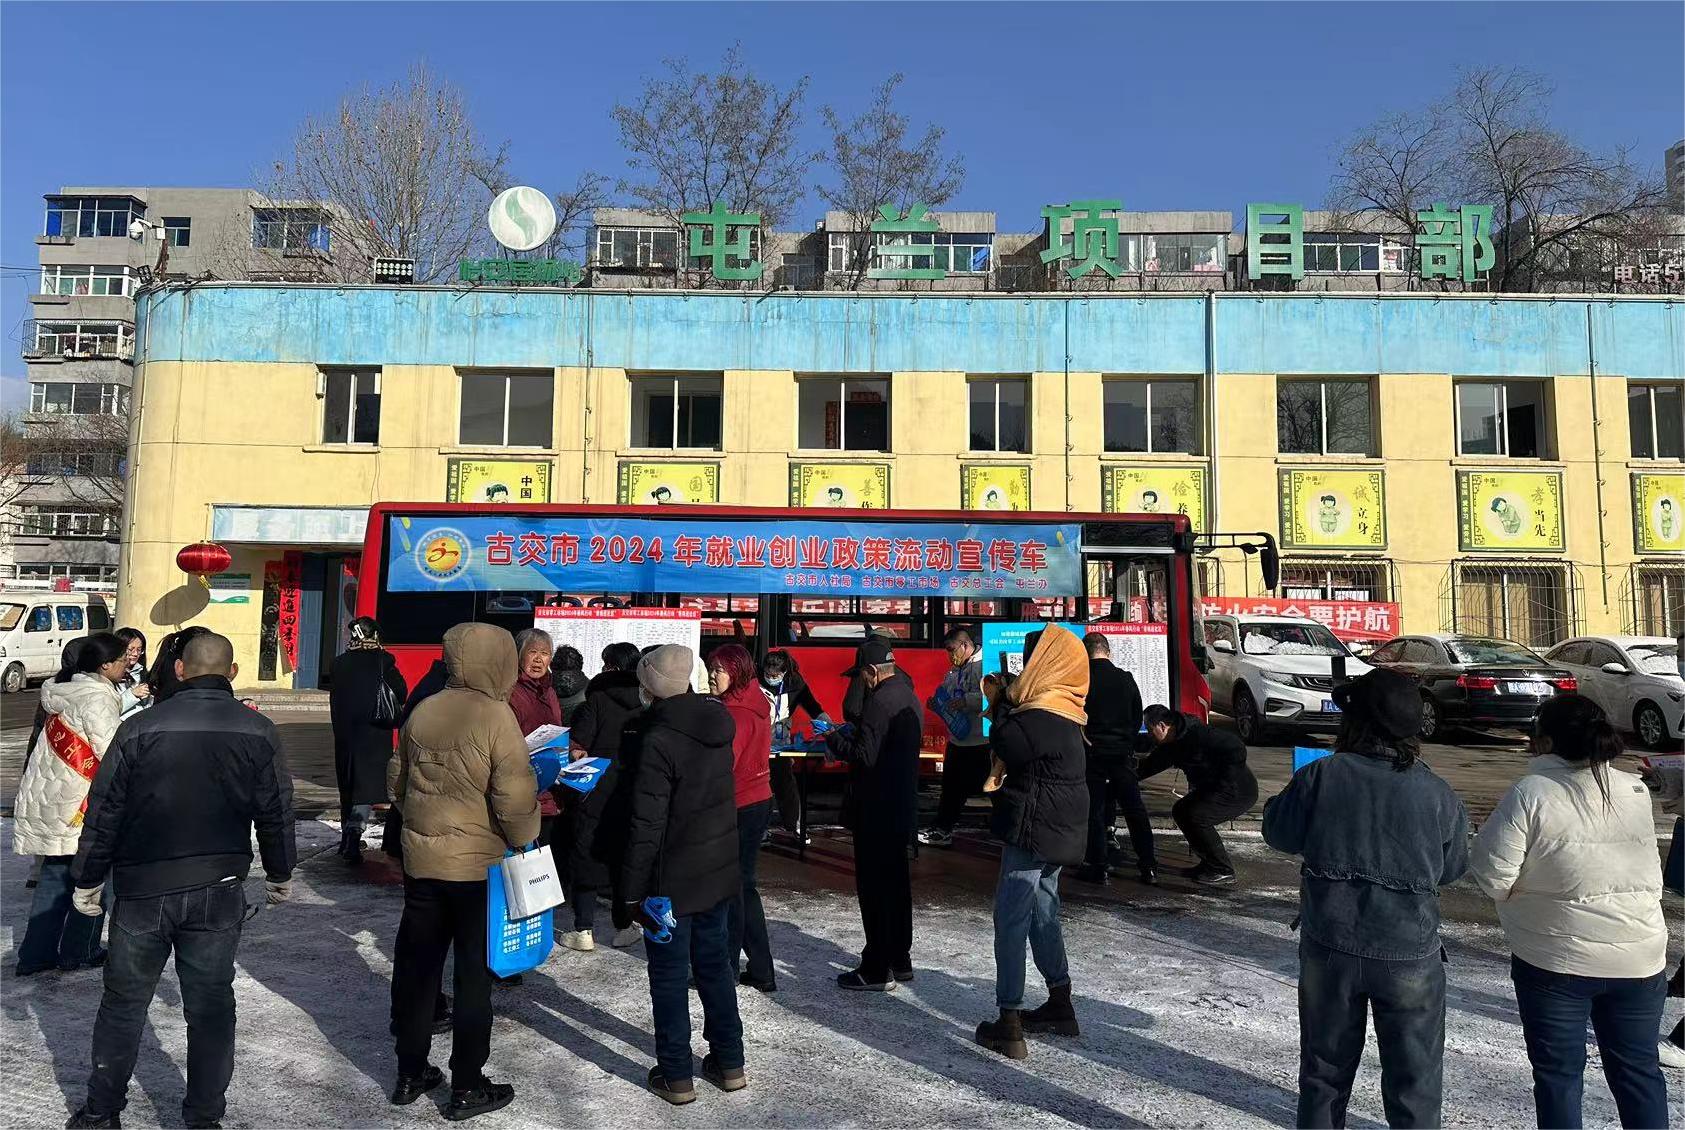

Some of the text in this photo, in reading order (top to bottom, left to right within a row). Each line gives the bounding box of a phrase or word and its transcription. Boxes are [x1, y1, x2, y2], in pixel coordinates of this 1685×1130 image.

[683, 199, 1494, 282] 屯兰项目部
[520, 475, 532, 499] 中国
[485, 531, 580, 566] 古交市
[590, 535, 663, 563] 2024
[672, 534, 1049, 573] 年就业创业政策流动宣传车
[784, 573, 852, 587] 古交市人社局
[949, 577, 1006, 591] 古交总工会
[528, 873, 550, 886] PHILIPS
